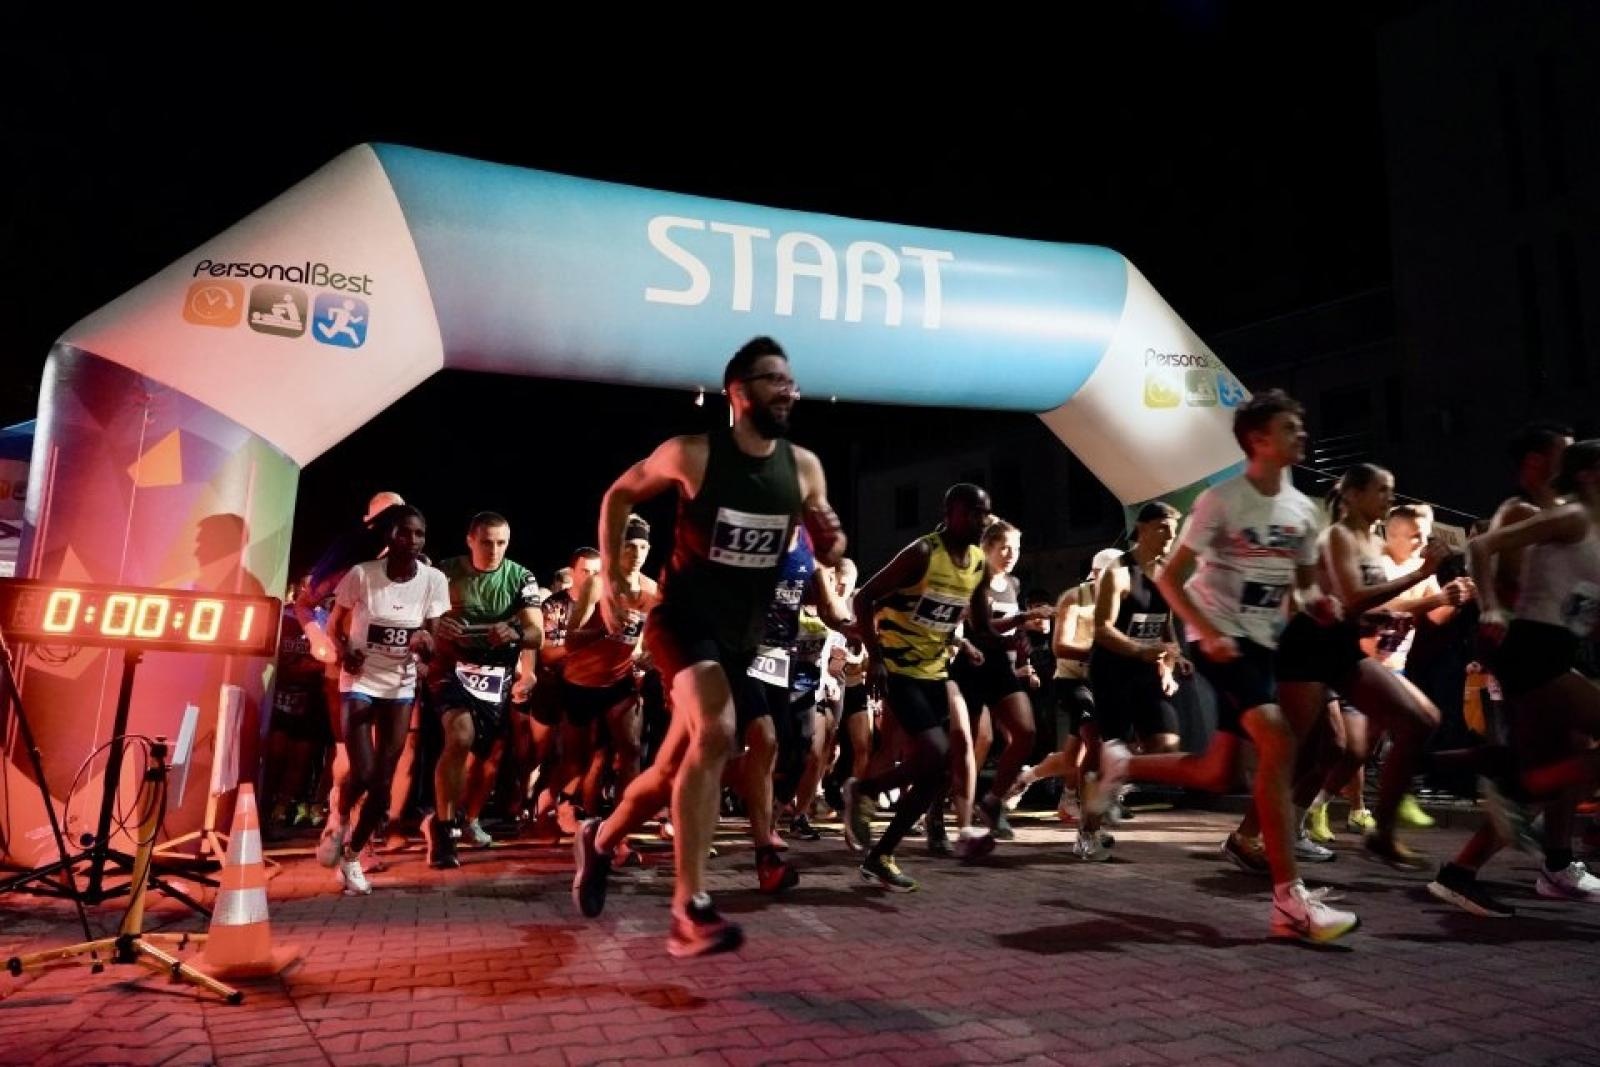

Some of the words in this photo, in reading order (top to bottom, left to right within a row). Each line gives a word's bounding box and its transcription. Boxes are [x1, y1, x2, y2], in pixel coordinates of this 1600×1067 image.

[193, 260, 373, 295] PersonalBest
[645, 216, 955, 329] START
[727, 527, 775, 552] 192
[43, 590, 255, 641] 0:00:01
[931, 604, 955, 621] 44
[383, 628, 408, 645] 38
[755, 656, 776, 673] 70
[469, 674, 489, 691] 96
